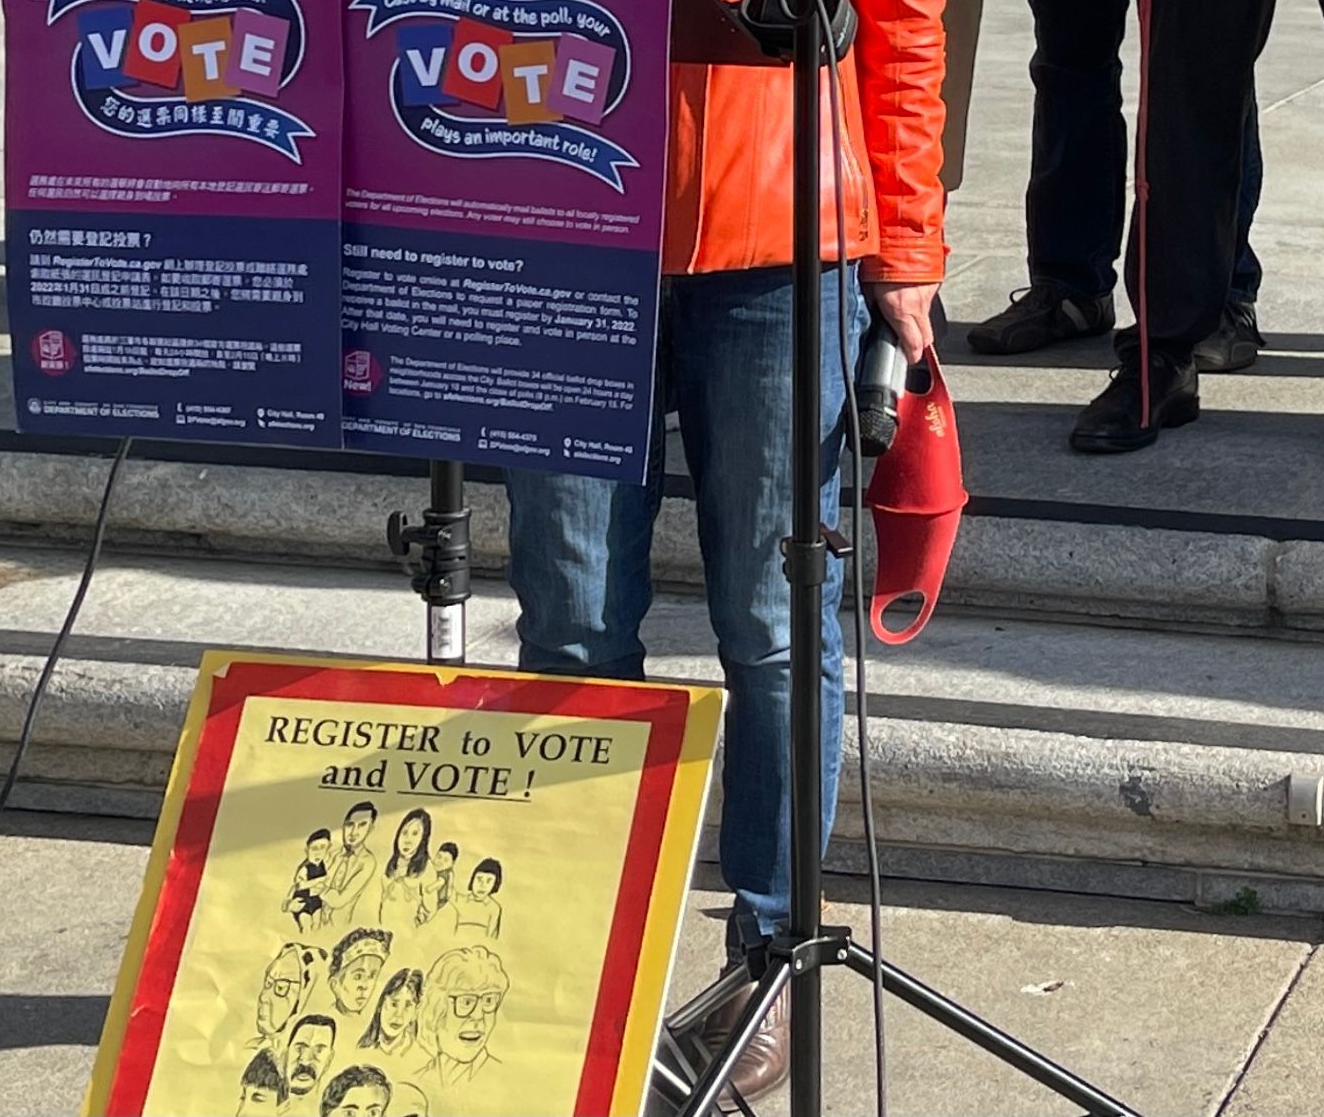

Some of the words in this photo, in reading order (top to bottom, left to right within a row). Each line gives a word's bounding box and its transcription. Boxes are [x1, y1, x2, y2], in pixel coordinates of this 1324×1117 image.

[473, 2, 491, 18] or
[493, 1, 511, 20] at
[513, 6, 538, 26] the
[577, 10, 611, 37] your
[87, 22, 275, 80] VOTE
[406, 42, 601, 104] VOTE
[420, 116, 461, 145] plays
[464, 131, 483, 146] an
[485, 128, 560, 151] important
[562, 139, 597, 163] role!
[343, 243, 368, 257] Still
[370, 245, 402, 260] need
[404, 249, 417, 262] to
[420, 252, 469, 270] register
[471, 256, 484, 269] to
[487, 258, 524, 273] vote?
[265, 715, 440, 753] REGISTER
[460, 731, 492, 756] to
[514, 731, 614, 765] VOTE
[320, 760, 388, 790] and
[405, 761, 512, 796] VOTE
